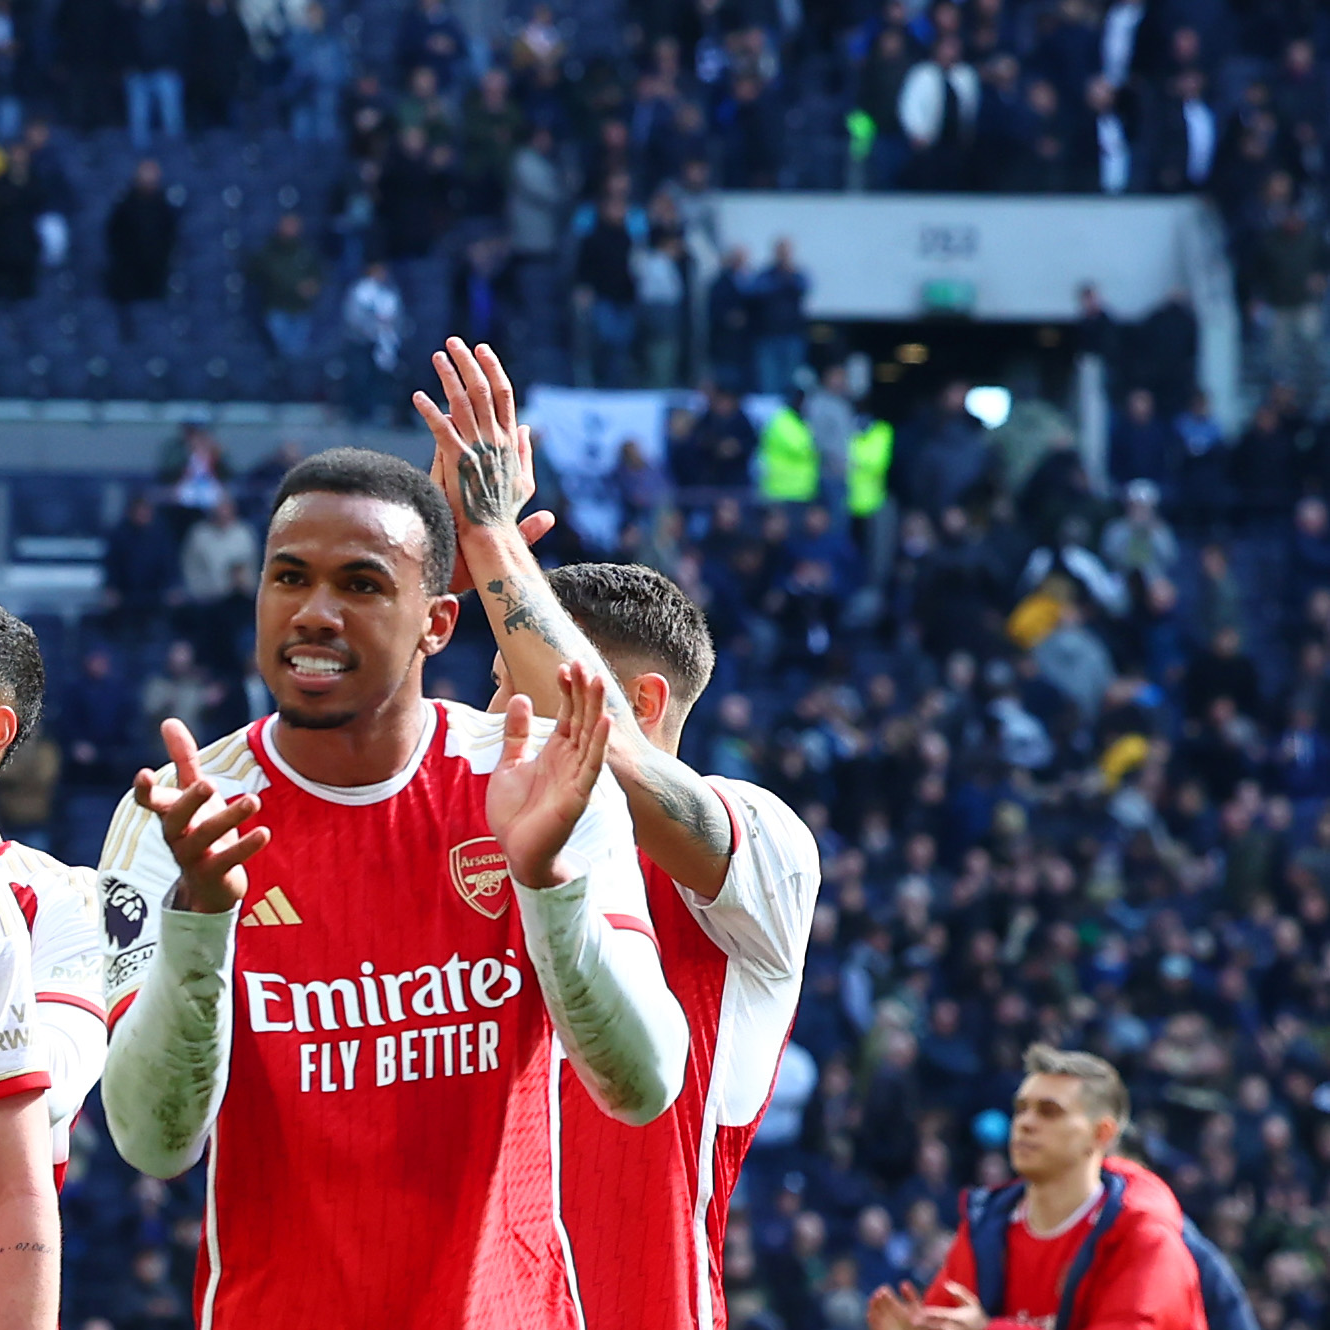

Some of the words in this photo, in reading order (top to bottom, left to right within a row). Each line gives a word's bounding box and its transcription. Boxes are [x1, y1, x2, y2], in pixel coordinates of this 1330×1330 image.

[460, 852, 507, 869] Arsena
[242, 948, 523, 1033] Emirates
[299, 1039, 362, 1094] FLY
[375, 1020, 501, 1088] BETTER
